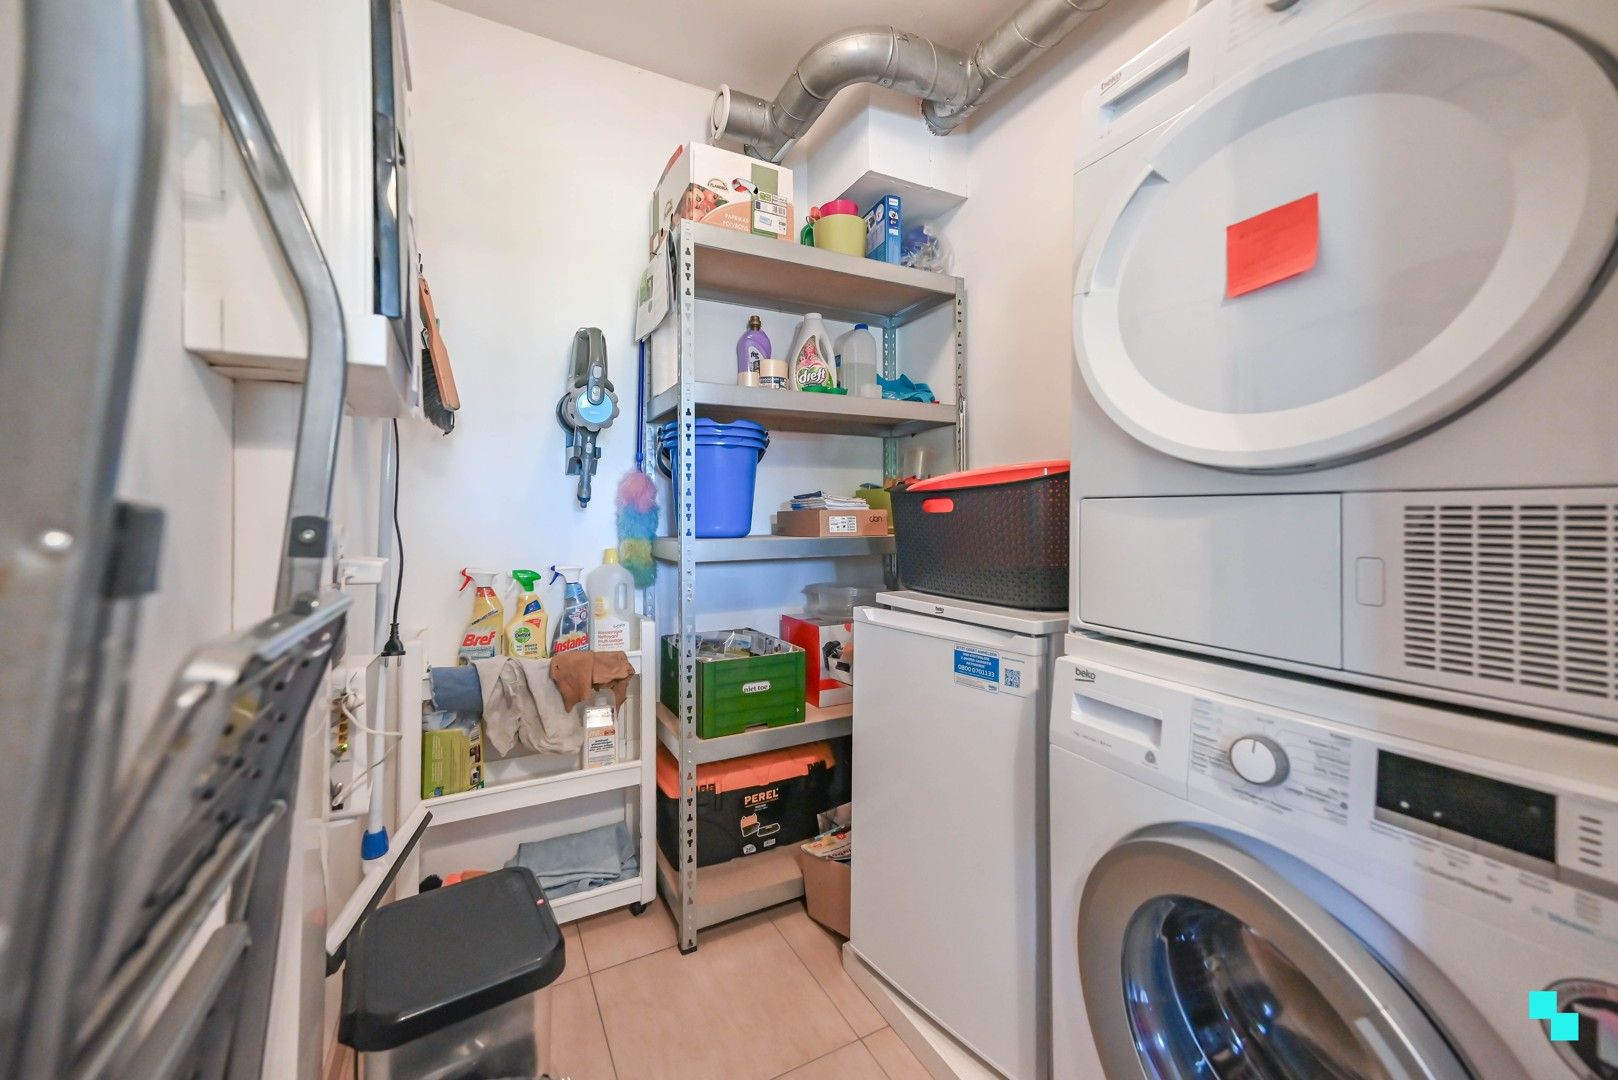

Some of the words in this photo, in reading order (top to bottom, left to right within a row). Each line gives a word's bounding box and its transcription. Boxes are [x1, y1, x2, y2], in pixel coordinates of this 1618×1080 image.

[798, 366, 826, 385] dreft
[462, 631, 496, 647] Bref
[1075, 667, 1096, 680] beko
[744, 789, 779, 805] PEREL
